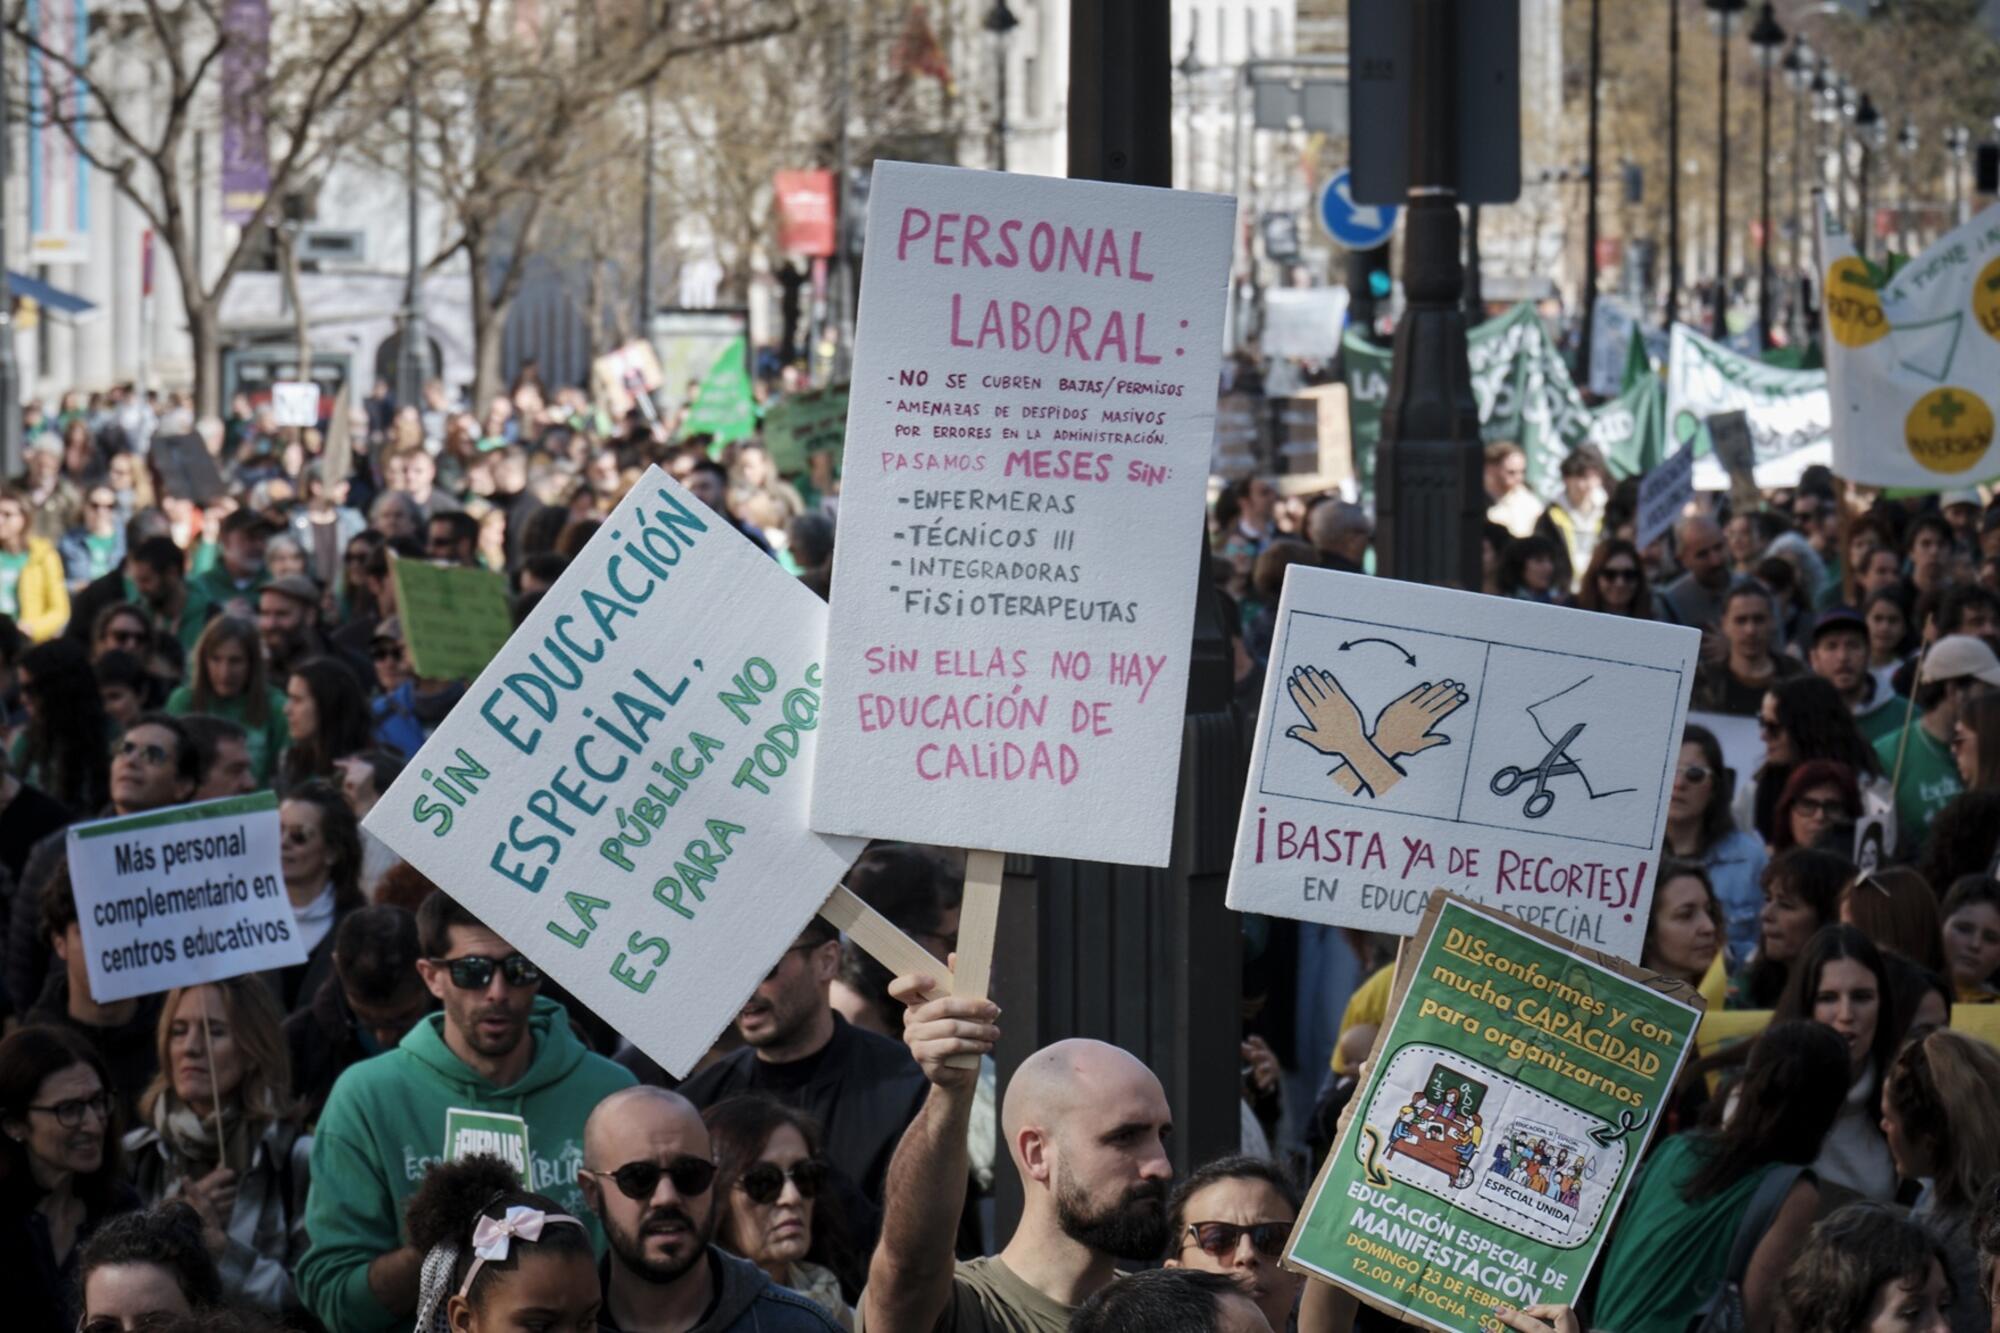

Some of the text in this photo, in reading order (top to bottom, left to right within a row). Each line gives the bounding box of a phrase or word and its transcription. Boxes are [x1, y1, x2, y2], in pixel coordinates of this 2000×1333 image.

[898, 207, 1154, 282] PERSONAL
[950, 293, 1189, 365] LABORAL:
[945, 374, 967, 389] SE
[982, 376, 1041, 390] CUBREN
[895, 425, 920, 438] POR
[933, 426, 991, 439] ERRORES
[1002, 428, 1019, 440] EN
[1027, 429, 1041, 440] LA
[995, 406, 1009, 418] DE
[1022, 406, 1088, 421] DESPIDOS
[1102, 409, 1166, 425] MASIVOS
[881, 452, 986, 472] PASAMOS
[1004, 450, 1113, 482] MESES
[413, 748, 491, 837] SIN
[479, 488, 708, 756] EDUCACIÓN
[864, 645, 1167, 703] SIN ELLAS NO HAY
[858, 684, 1113, 736] EDUCACIÓN DE
[916, 741, 1080, 785] CALIDAD
[546, 656, 777, 949] LA PÚBLICA NO
[115, 826, 247, 875] Más personal
[1255, 806, 1648, 923] ¡BASTA YA DE RECORTES!
[94, 873, 279, 928] complementario en
[609, 930, 671, 994] ES
[653, 818, 746, 920] PARA
[1304, 877, 1339, 902] EN
[101, 918, 290, 973] centros educativos
[1444, 927, 1674, 1046] DISconformes y con
[1432, 965, 1661, 1076] mucha CAPACIDAD
[1418, 998, 1644, 1108] para organizarnos
[1484, 1178, 1571, 1224] ESPECIAL UNIDA
[1346, 1180, 1569, 1291] EDUCACIÓN ESPECIAL DE
[1346, 1232, 1420, 1274] DOMINGO
[1422, 1267, 1442, 1286] 23
[1443, 1276, 1464, 1295] DE
[1350, 1207, 1543, 1306] MANIFESTACIÓN
[1351, 1257, 1393, 1285] 12.00
[1393, 1276, 1406, 1291] H
[1406, 1282, 1466, 1318] ATOCHA
